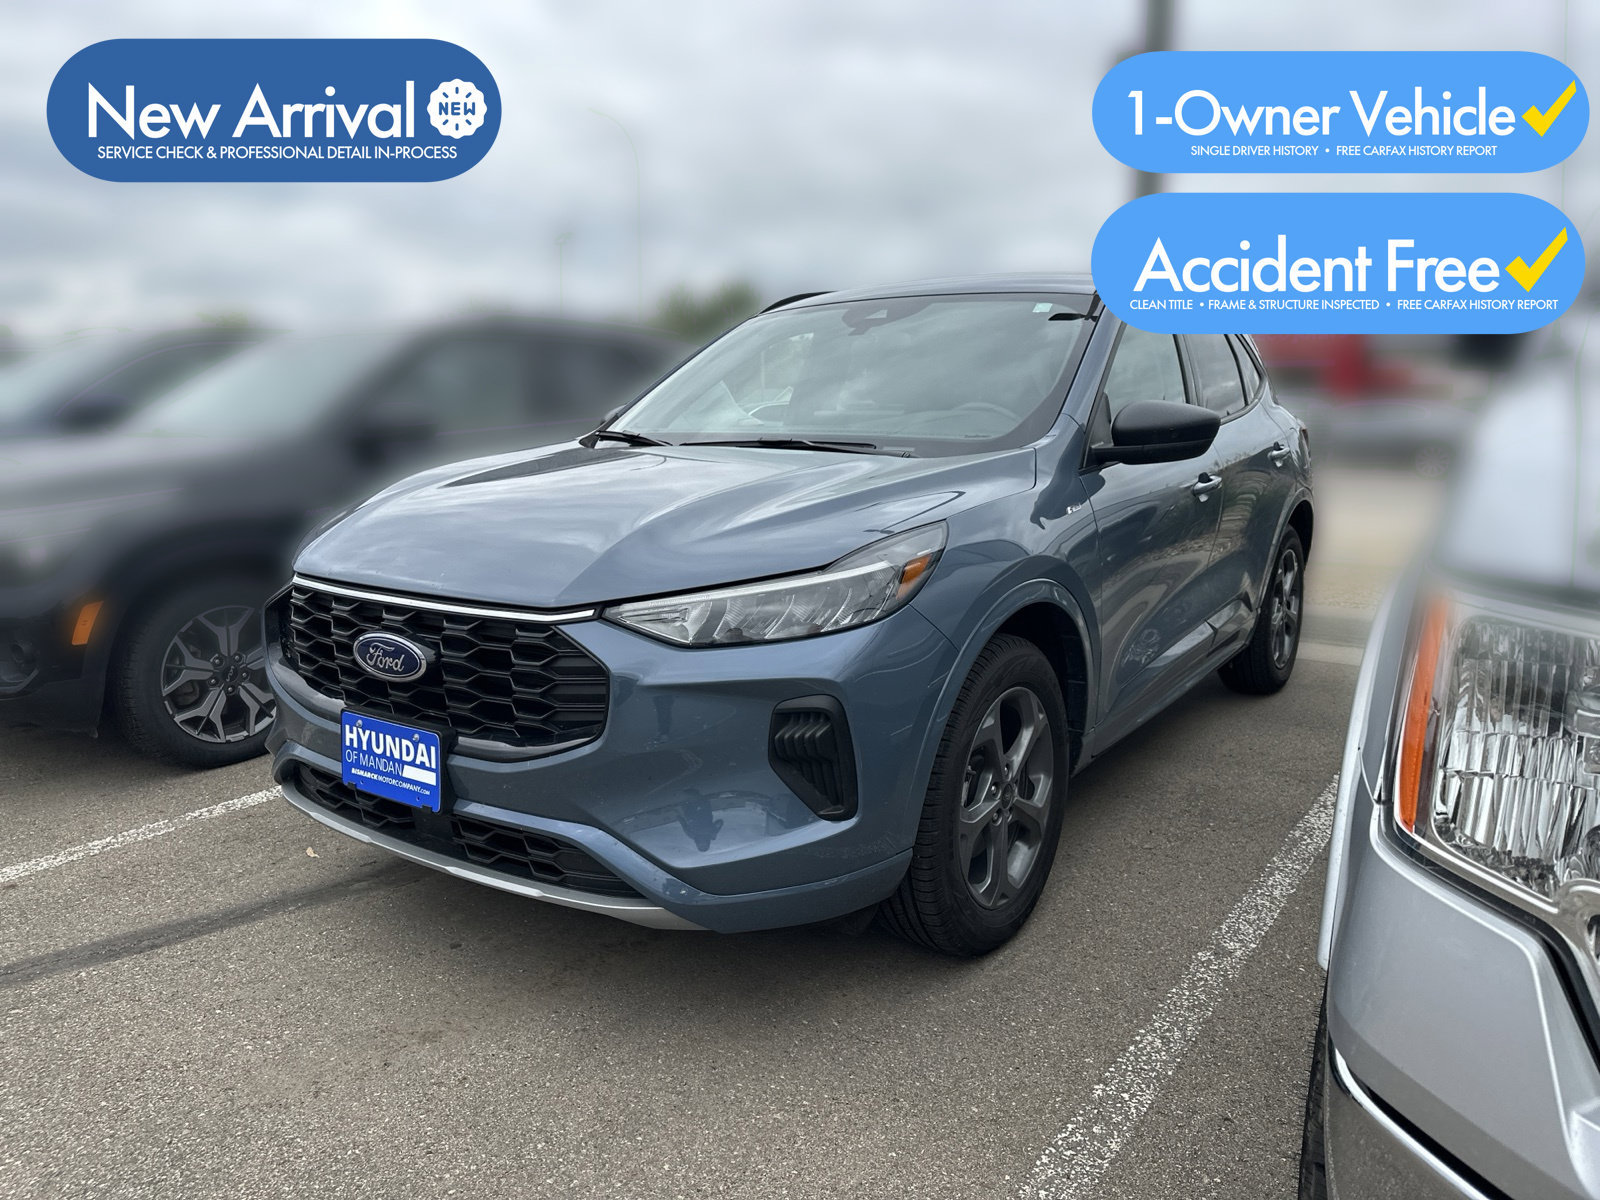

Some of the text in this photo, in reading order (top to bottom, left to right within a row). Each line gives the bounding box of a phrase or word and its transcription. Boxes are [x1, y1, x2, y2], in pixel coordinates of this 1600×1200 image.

[366, 642, 405, 672] Ford
[345, 724, 437, 769] HYUNDAI
[345, 749, 403, 777] OF MANDAN
